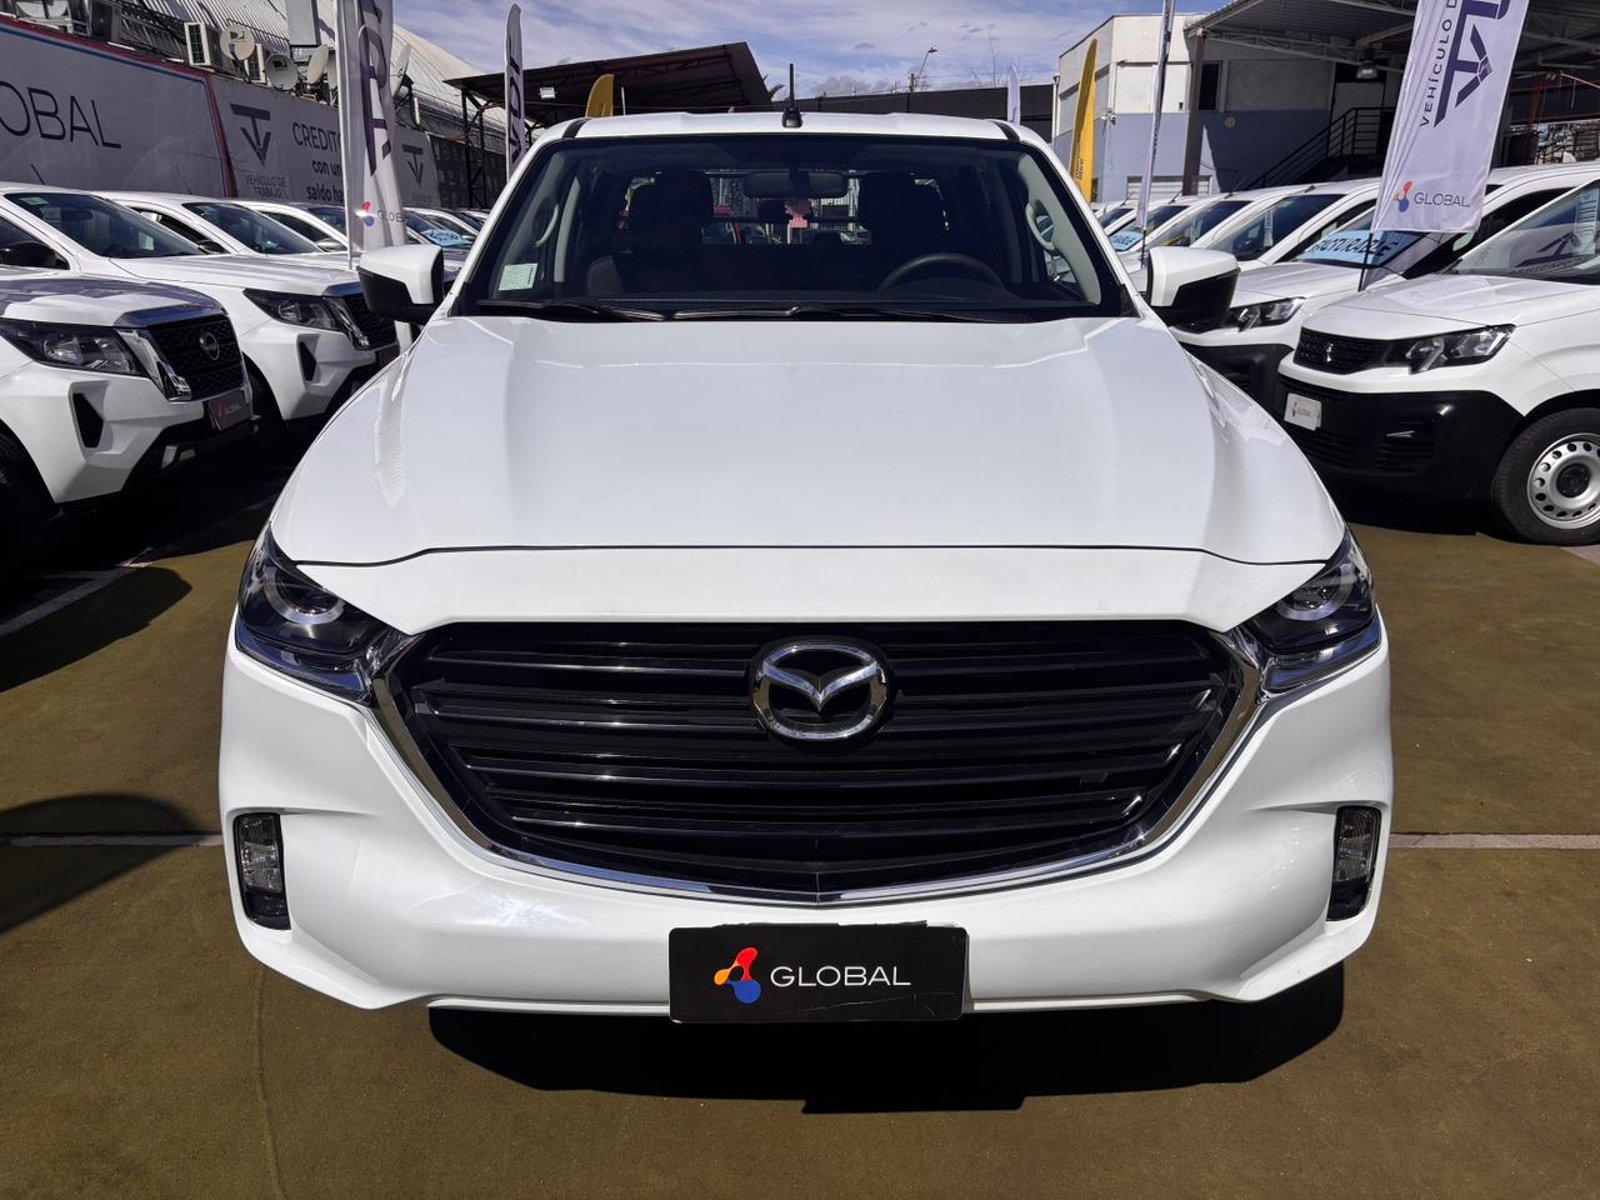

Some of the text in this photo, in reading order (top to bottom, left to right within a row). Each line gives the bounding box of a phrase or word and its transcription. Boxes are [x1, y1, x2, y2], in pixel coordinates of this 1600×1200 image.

[312, 160, 330, 176] con
[306, 182, 331, 201] saldo
[1414, 192, 1471, 207] GLOBAL
[770, 966, 912, 987] GLOBAL
